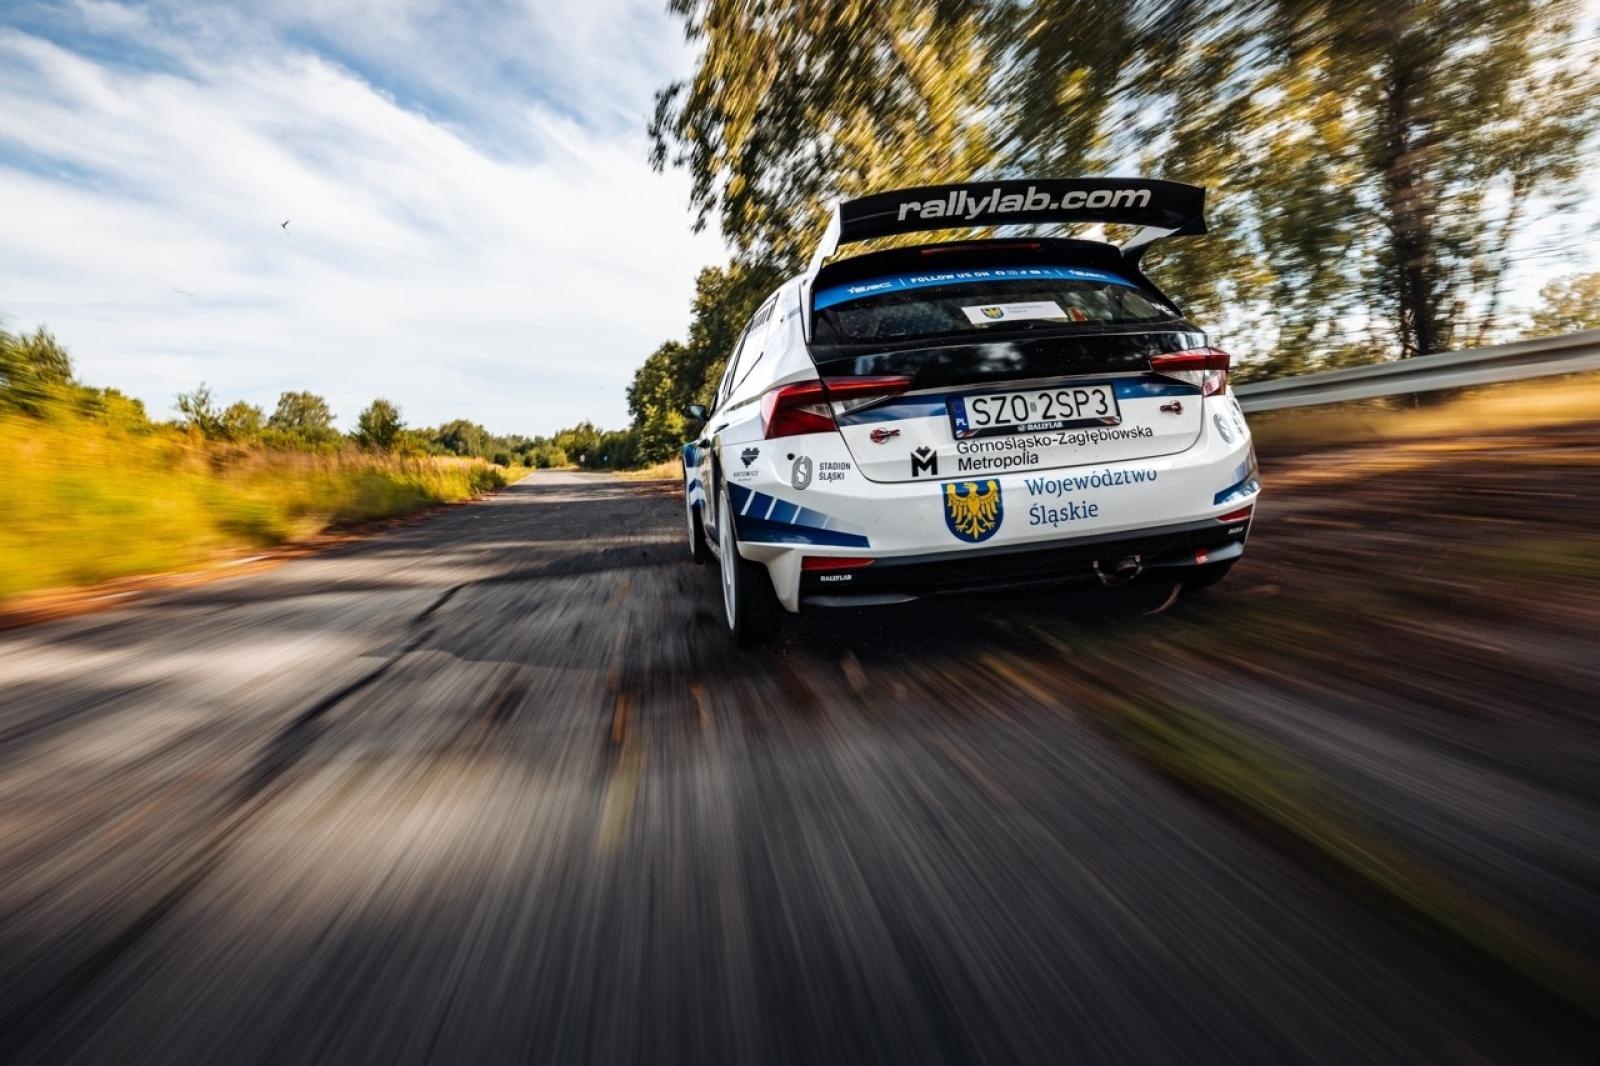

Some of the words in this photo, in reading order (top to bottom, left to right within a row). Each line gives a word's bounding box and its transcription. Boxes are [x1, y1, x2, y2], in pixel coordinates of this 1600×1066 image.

[898, 186, 1152, 221] rallylab.com
[910, 274, 955, 284] FOLLOW
[1038, 389, 1109, 420] 2SP3
[956, 418, 967, 427] PL
[1027, 421, 1064, 432] RALLYLAB
[956, 425, 1154, 454] Górnośląsko-Zagłębiowska
[819, 462, 851, 470] STADION
[958, 452, 1039, 471] Metropolia
[1024, 469, 1158, 496] Województwo
[1029, 501, 1099, 527] Śląskie
